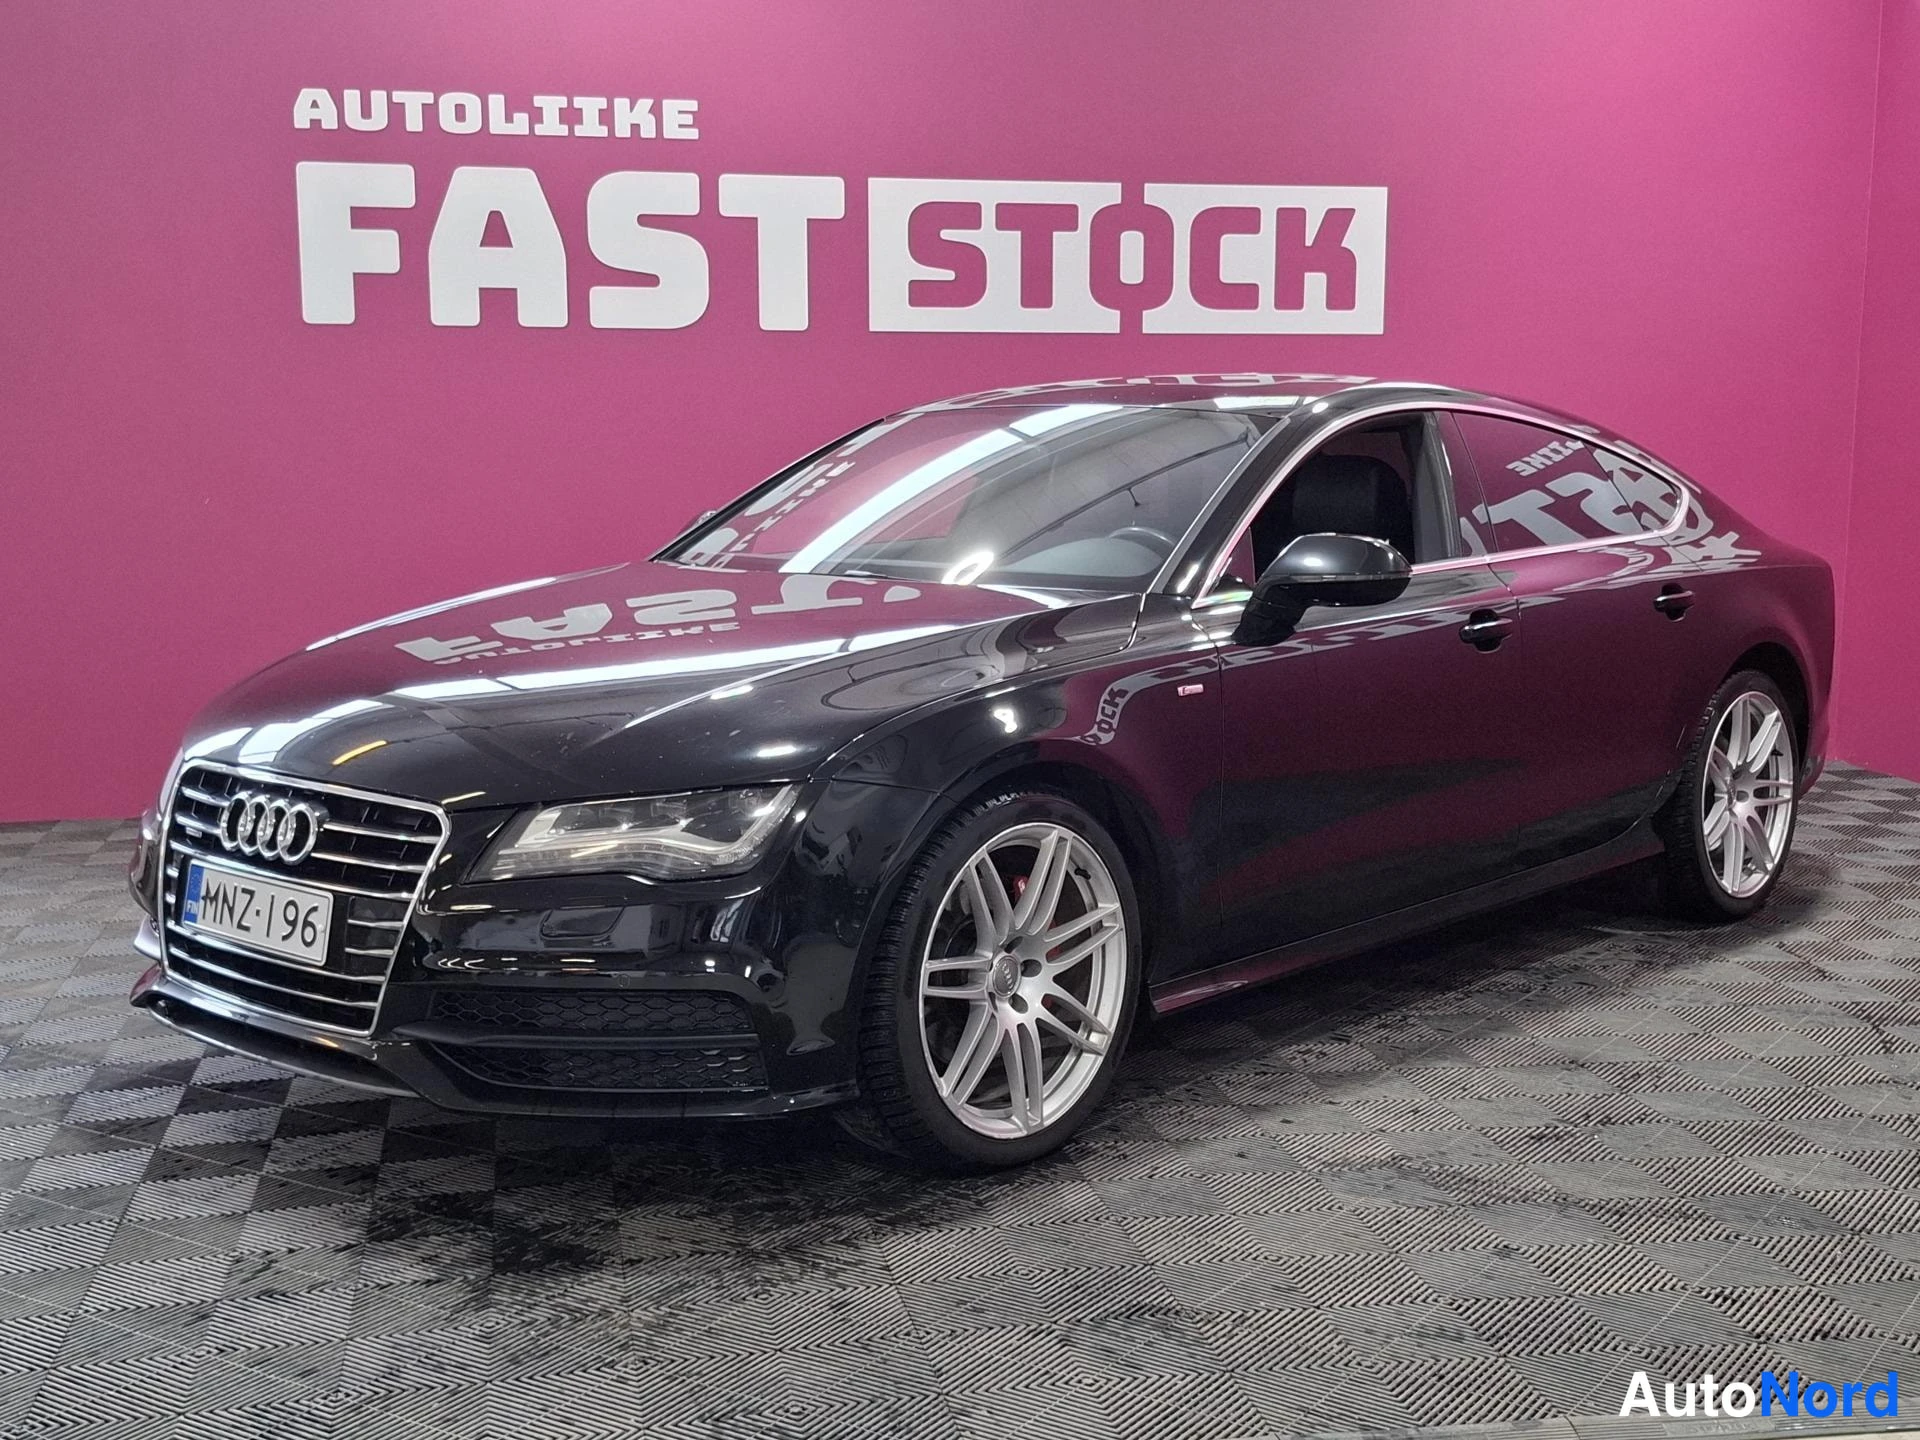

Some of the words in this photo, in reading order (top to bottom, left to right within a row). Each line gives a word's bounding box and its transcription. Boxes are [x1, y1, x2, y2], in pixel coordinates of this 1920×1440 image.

[293, 88, 699, 139] AUTOLIIKE
[296, 161, 846, 331] FAST
[907, 200, 1358, 312] STOCK
[202, 878, 319, 948] MNZ-196
